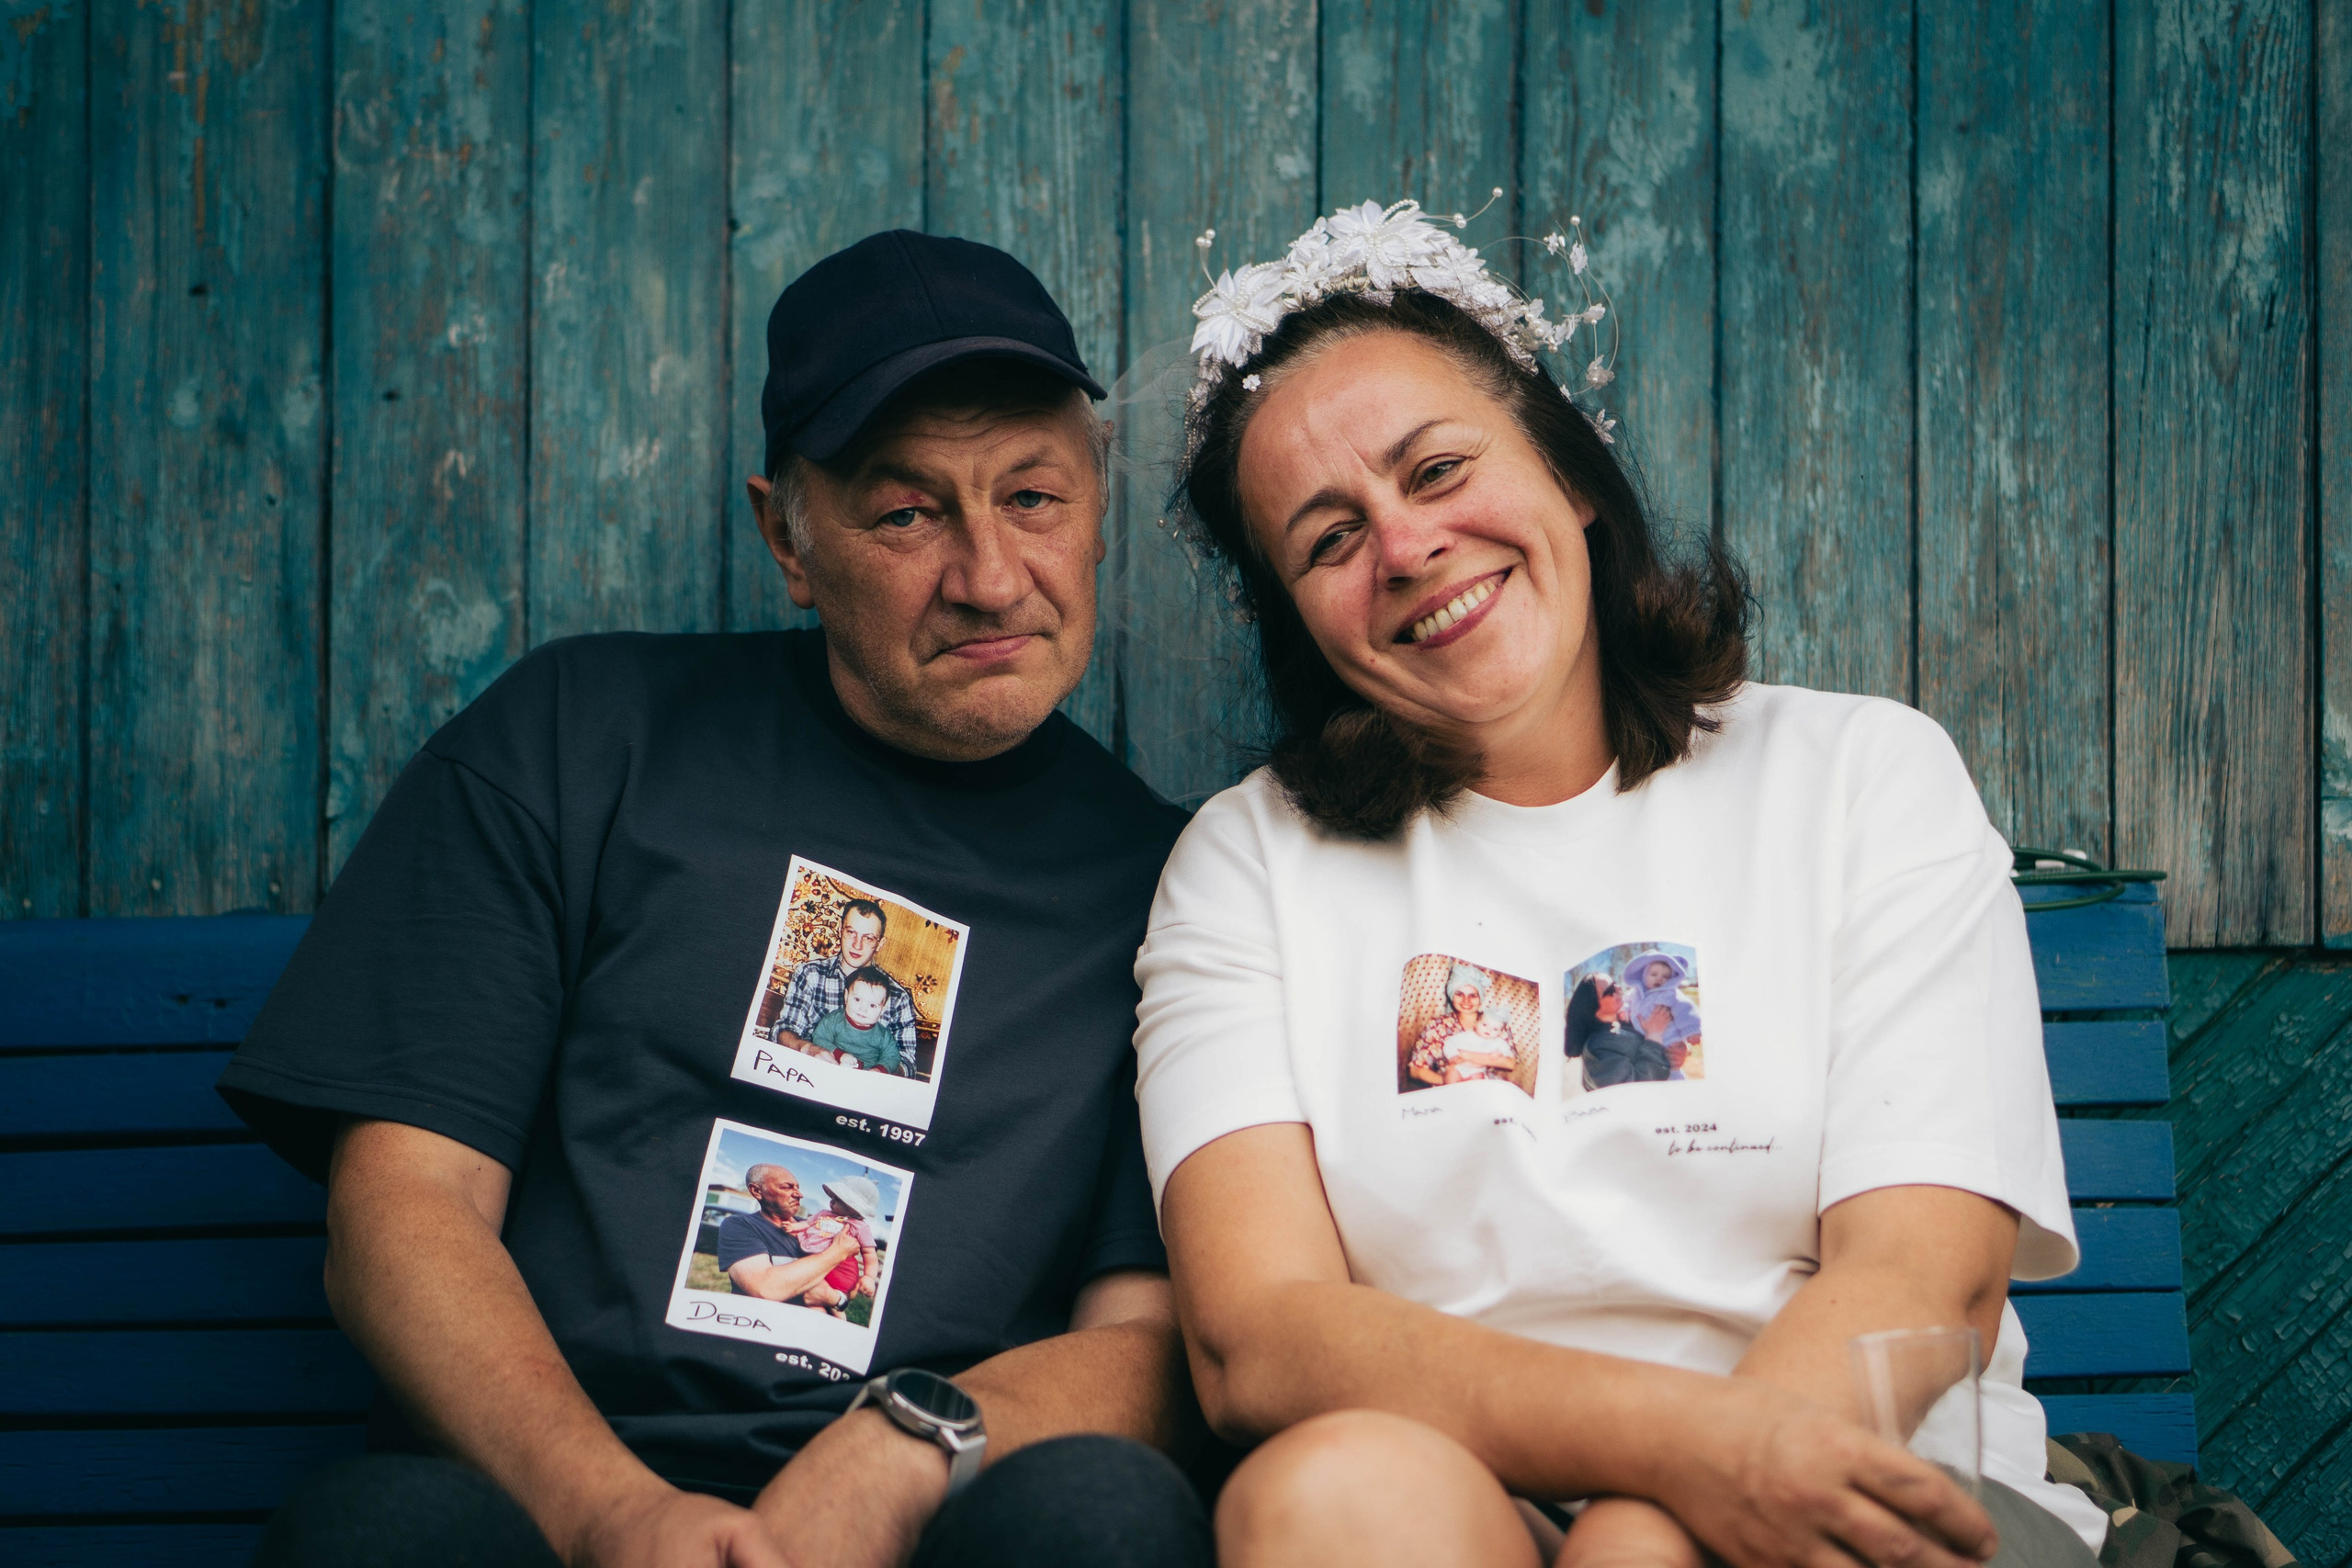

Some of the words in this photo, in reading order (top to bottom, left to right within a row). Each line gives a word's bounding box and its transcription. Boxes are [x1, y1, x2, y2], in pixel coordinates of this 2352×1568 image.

[835, 1114, 871, 1133] est.
[879, 1123, 926, 1146] 1997
[1655, 1125, 1680, 1134] est.
[1684, 1122, 1718, 1134] 2024
[1668, 1140, 1682, 1156] to
[1687, 1138, 1702, 1154] be
[775, 1352, 813, 1371] est.
